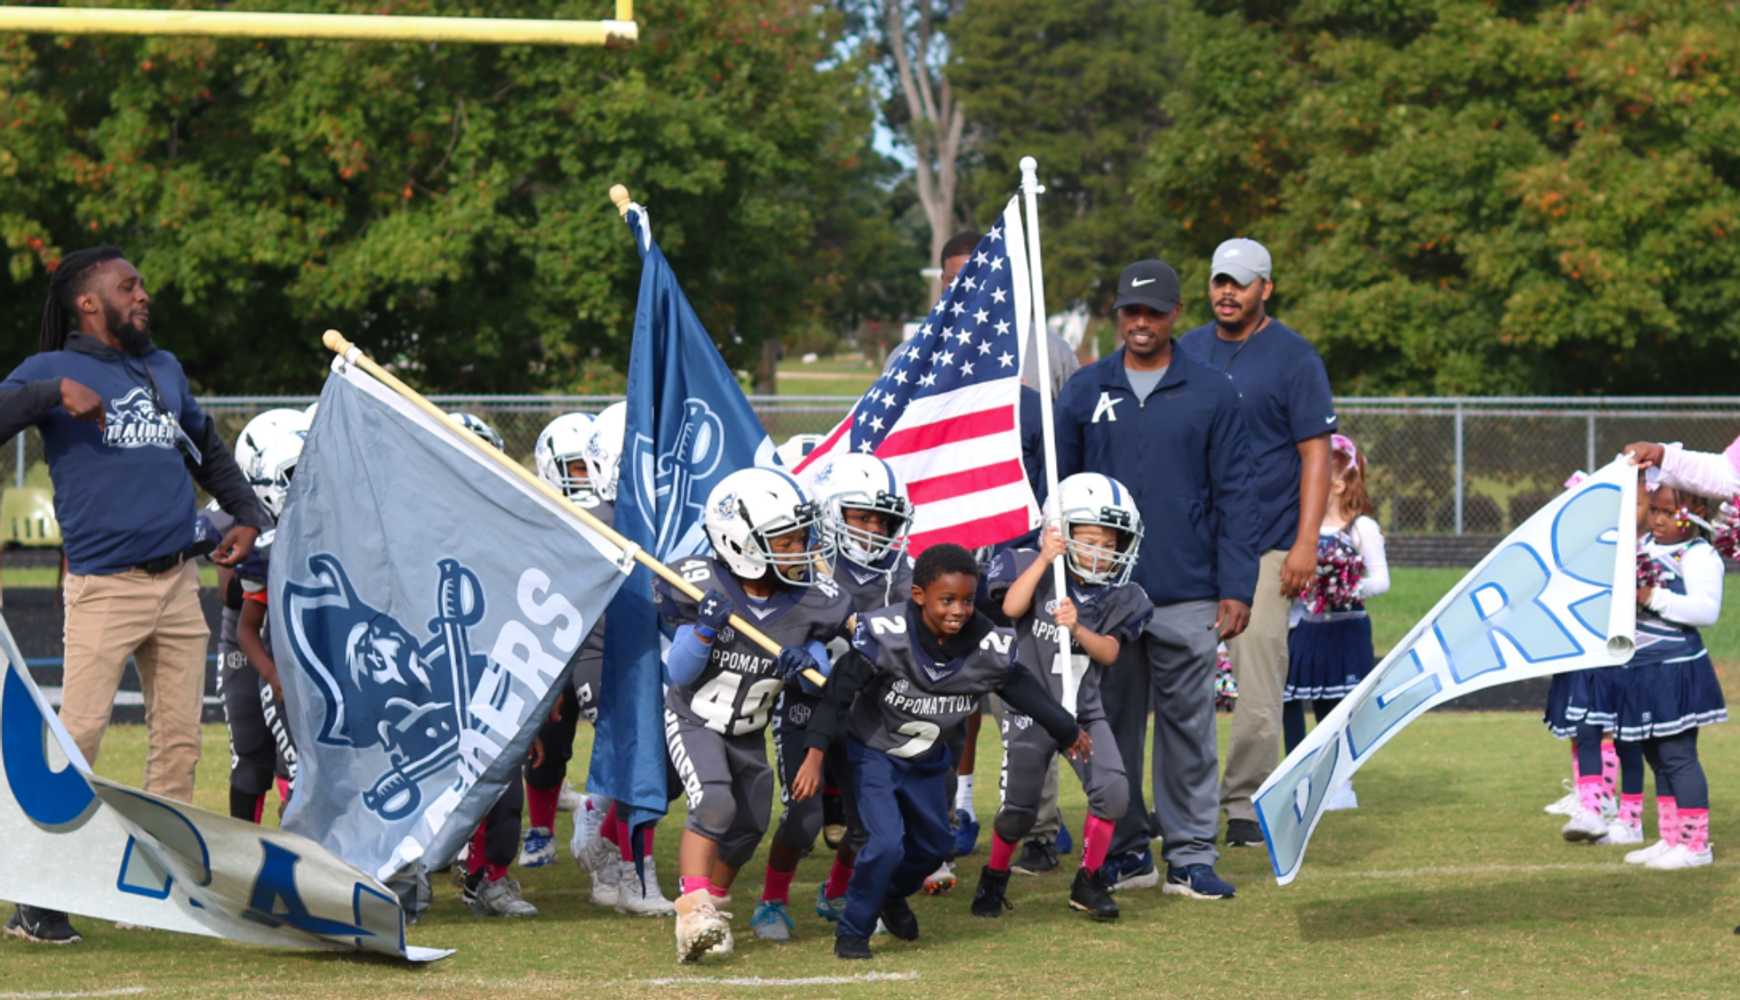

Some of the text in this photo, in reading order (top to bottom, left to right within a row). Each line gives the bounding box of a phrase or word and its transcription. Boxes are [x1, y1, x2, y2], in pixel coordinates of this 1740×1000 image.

[103, 422, 175, 440] RAIDER
[680, 560, 711, 583] 49
[871, 615, 907, 634] 2
[979, 631, 1014, 655] 2
[712, 649, 779, 677] PPOMAT
[691, 670, 784, 736] 49
[885, 720, 940, 758] 2
